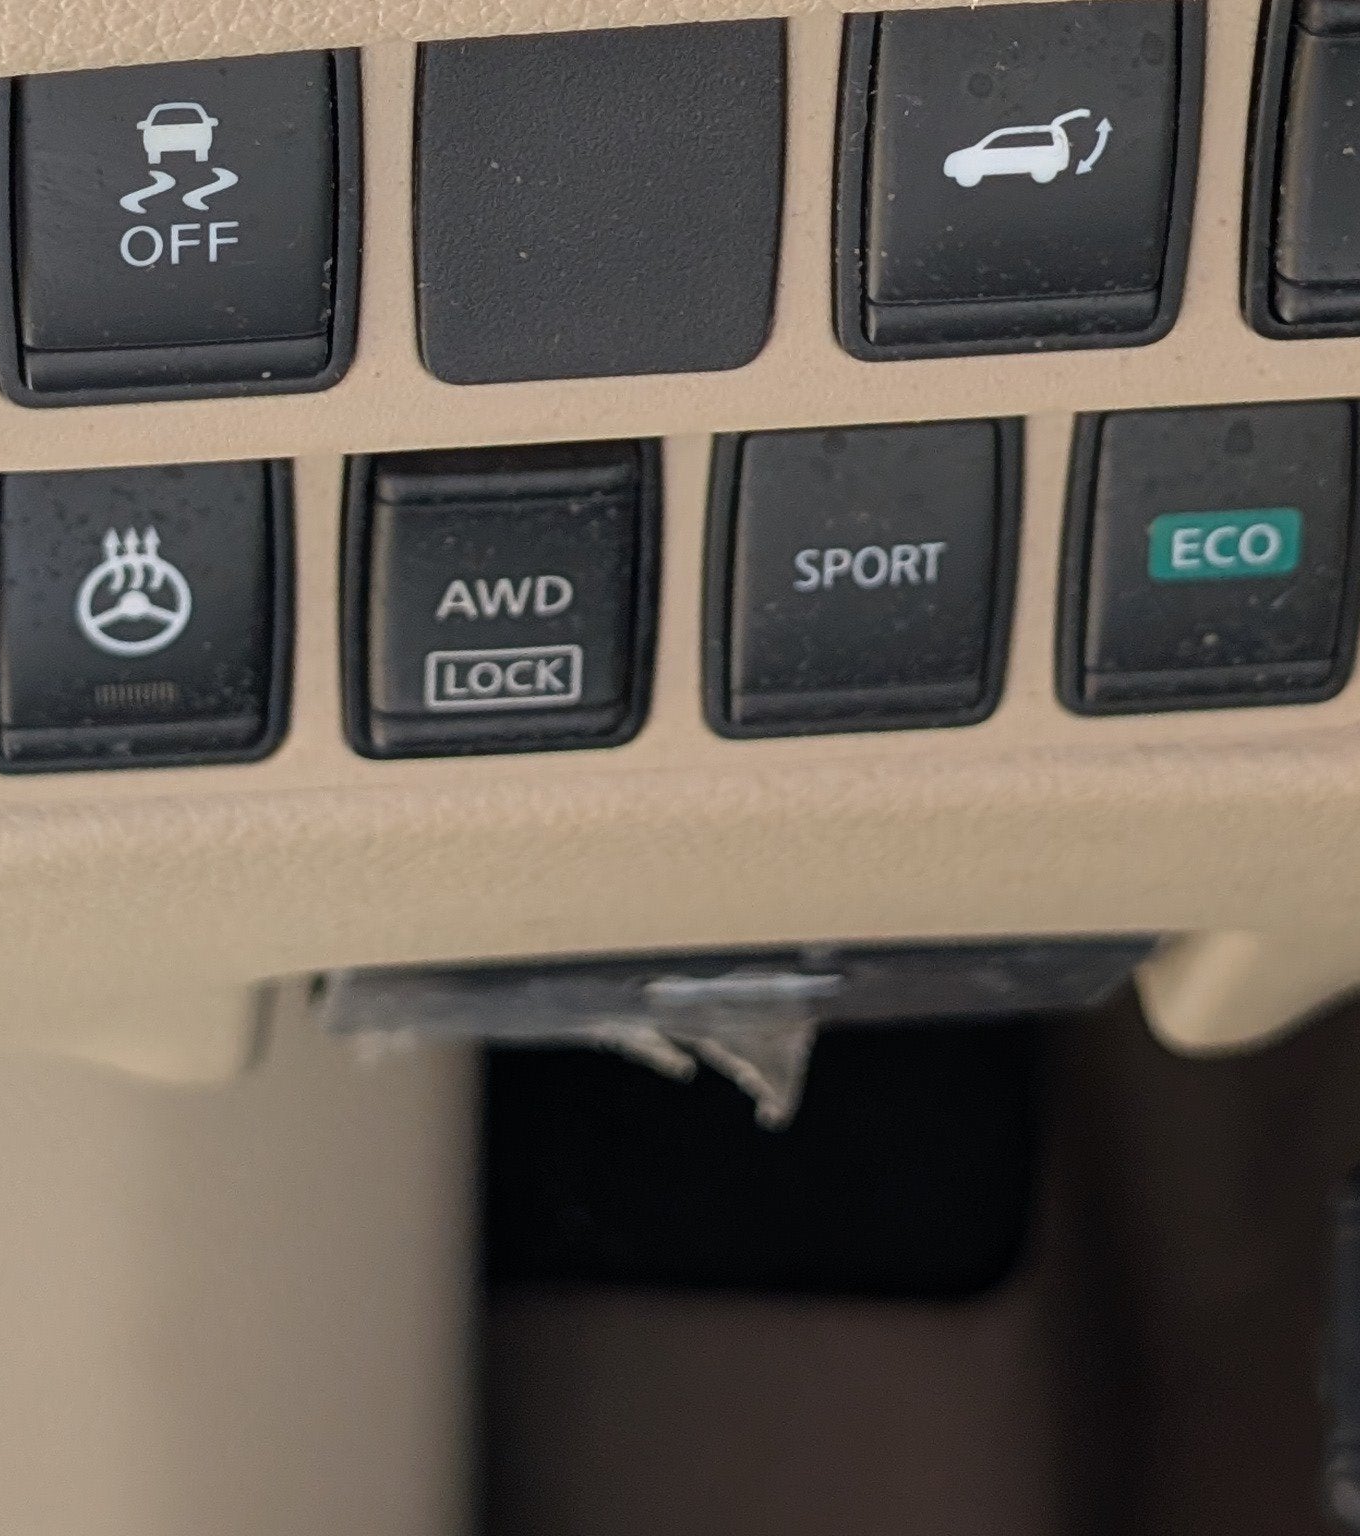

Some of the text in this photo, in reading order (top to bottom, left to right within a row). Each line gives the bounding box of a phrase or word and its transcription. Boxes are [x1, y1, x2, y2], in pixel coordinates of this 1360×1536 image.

[120, 221, 239, 267] OFF
[793, 541, 947, 593] SPORT
[1171, 522, 1282, 570] ECO
[436, 575, 574, 622] AWD
[443, 658, 566, 696] LOCK
